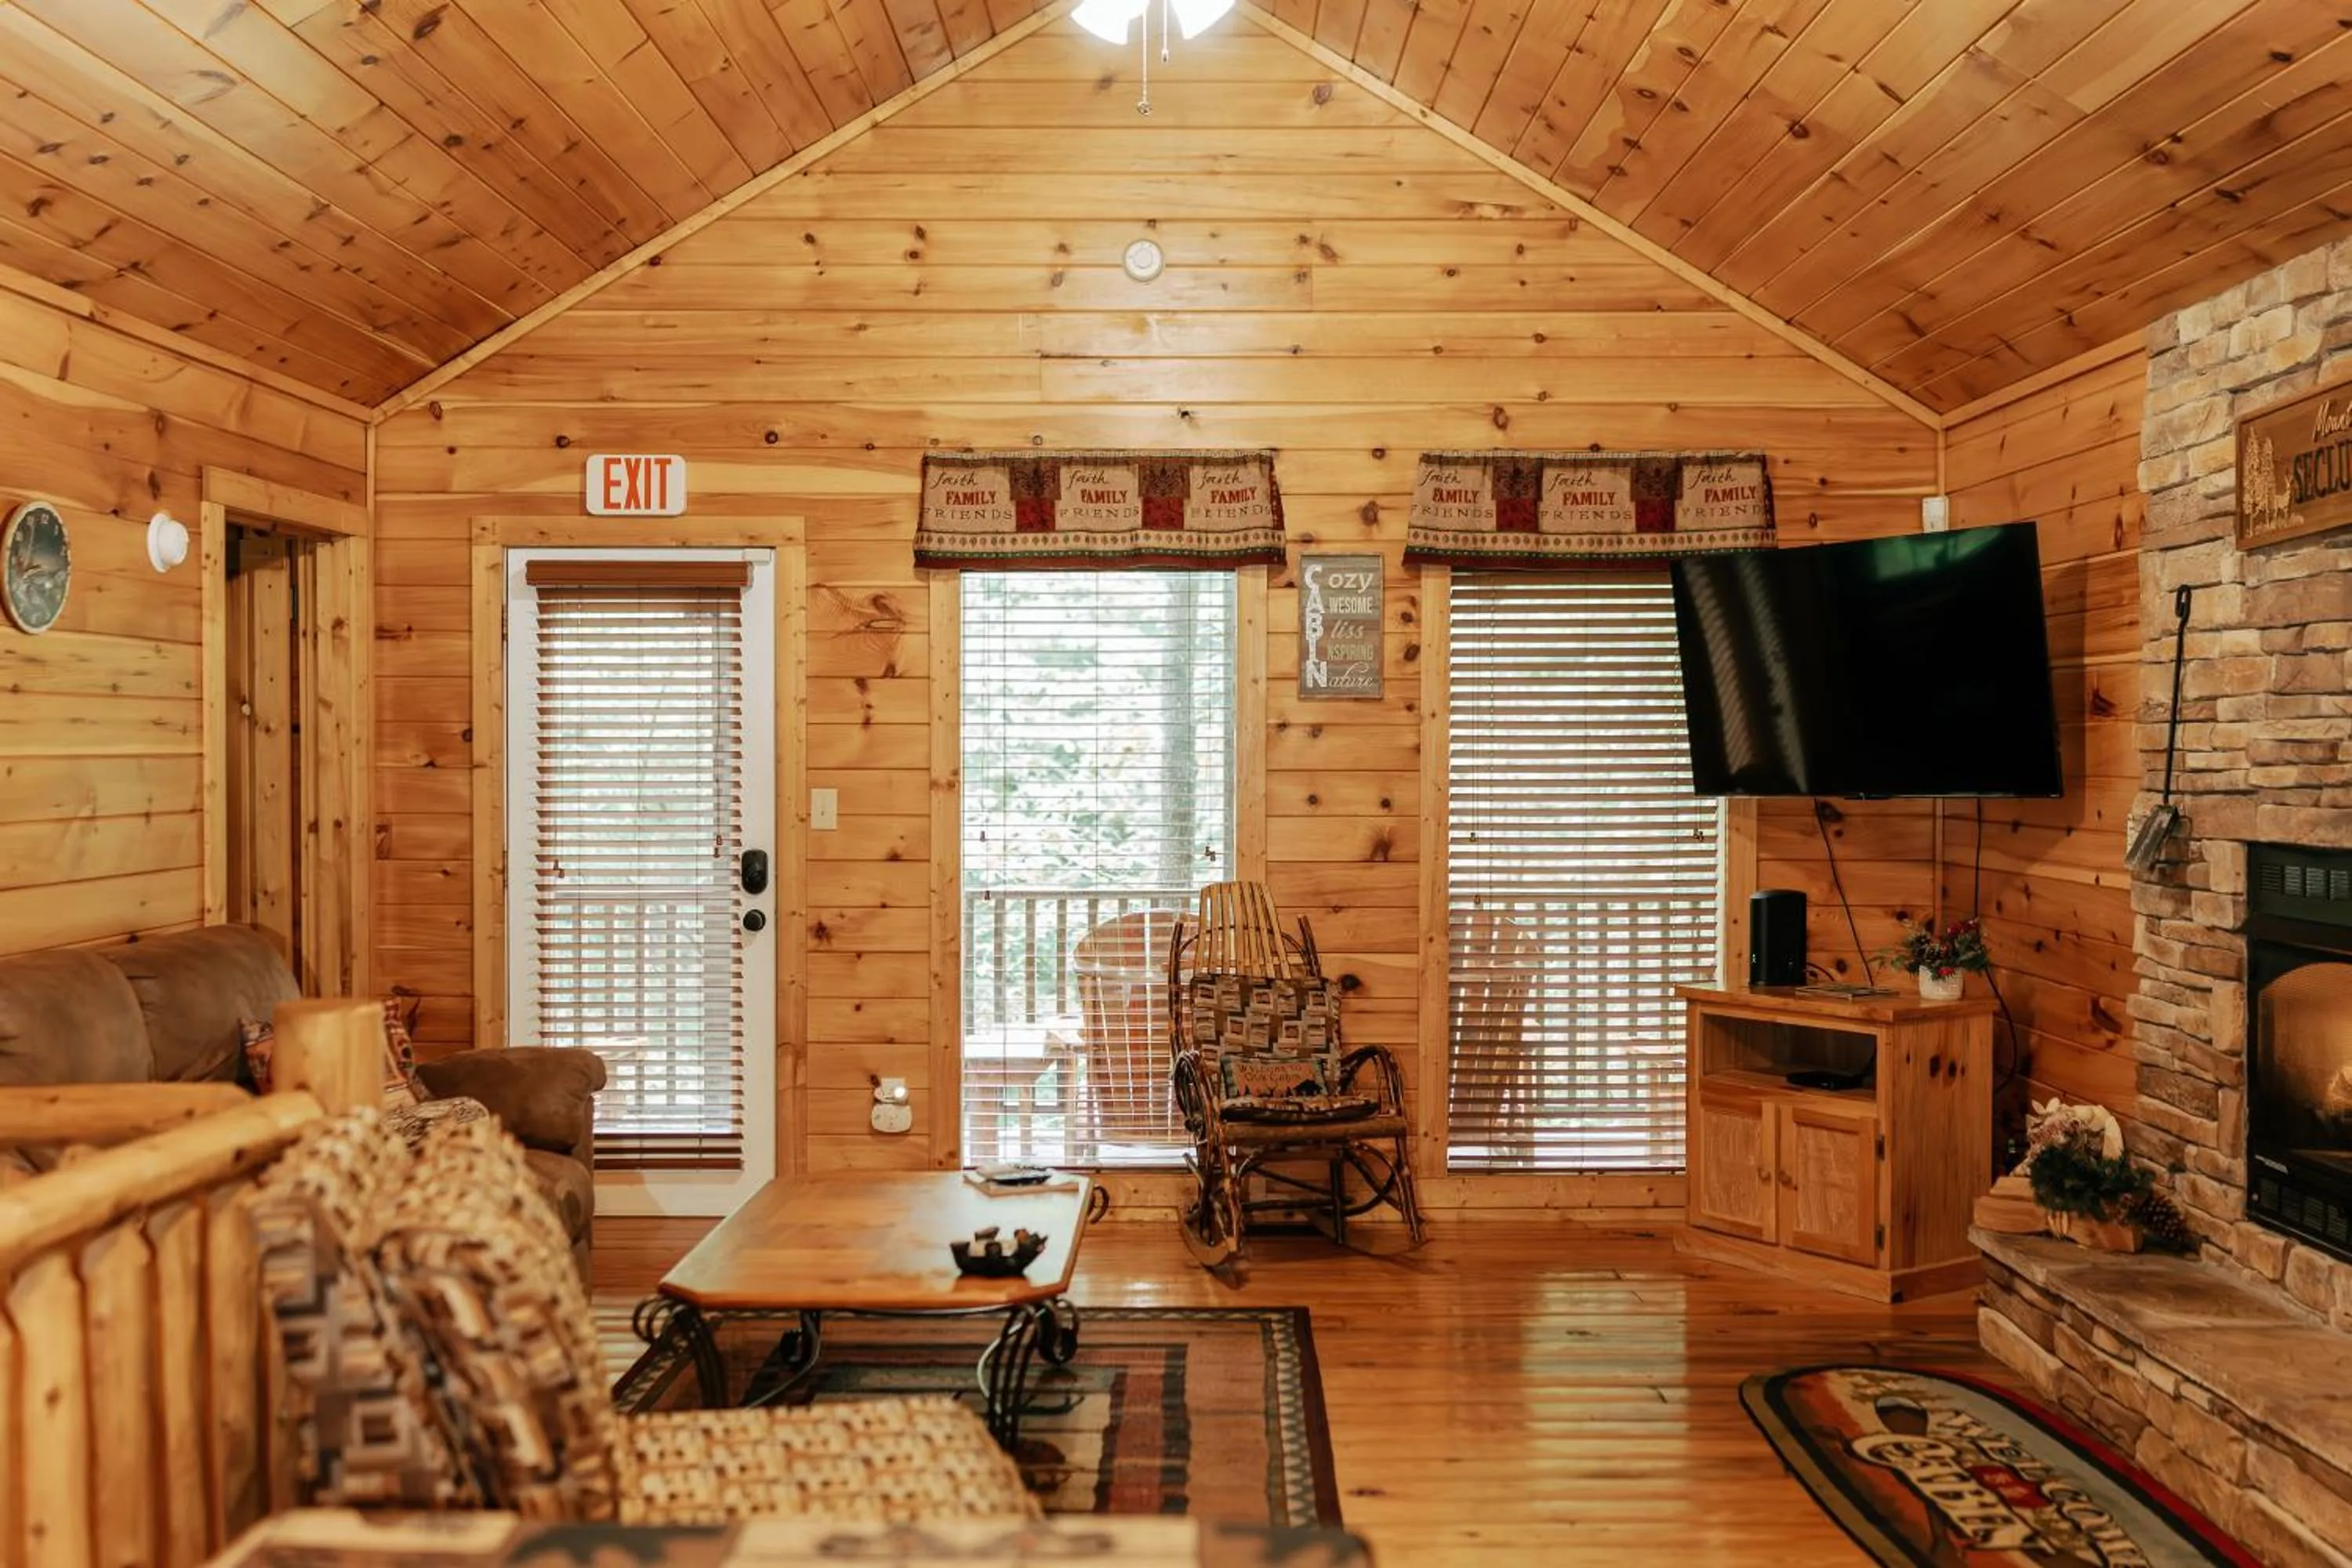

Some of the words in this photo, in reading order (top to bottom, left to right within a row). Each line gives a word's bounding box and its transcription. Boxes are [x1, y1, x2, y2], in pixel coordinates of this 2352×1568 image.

[2294, 439, 2352, 503] SECLU
[604, 458, 672, 510] EXIT
[1067, 470, 1110, 489] faith
[946, 490, 996, 506] FAMILY
[1080, 488, 1127, 504] FAMILY
[1210, 486, 1257, 504] FAMILY
[1432, 487, 1479, 503] FAMILY
[1563, 492, 1617, 506] FAMILY
[1704, 485, 1756, 503] FAMILY
[1060, 506, 1139, 518] FRIENDS
[1540, 510, 1632, 520] FRIENDS
[1682, 504, 1766, 518] FRIEND
